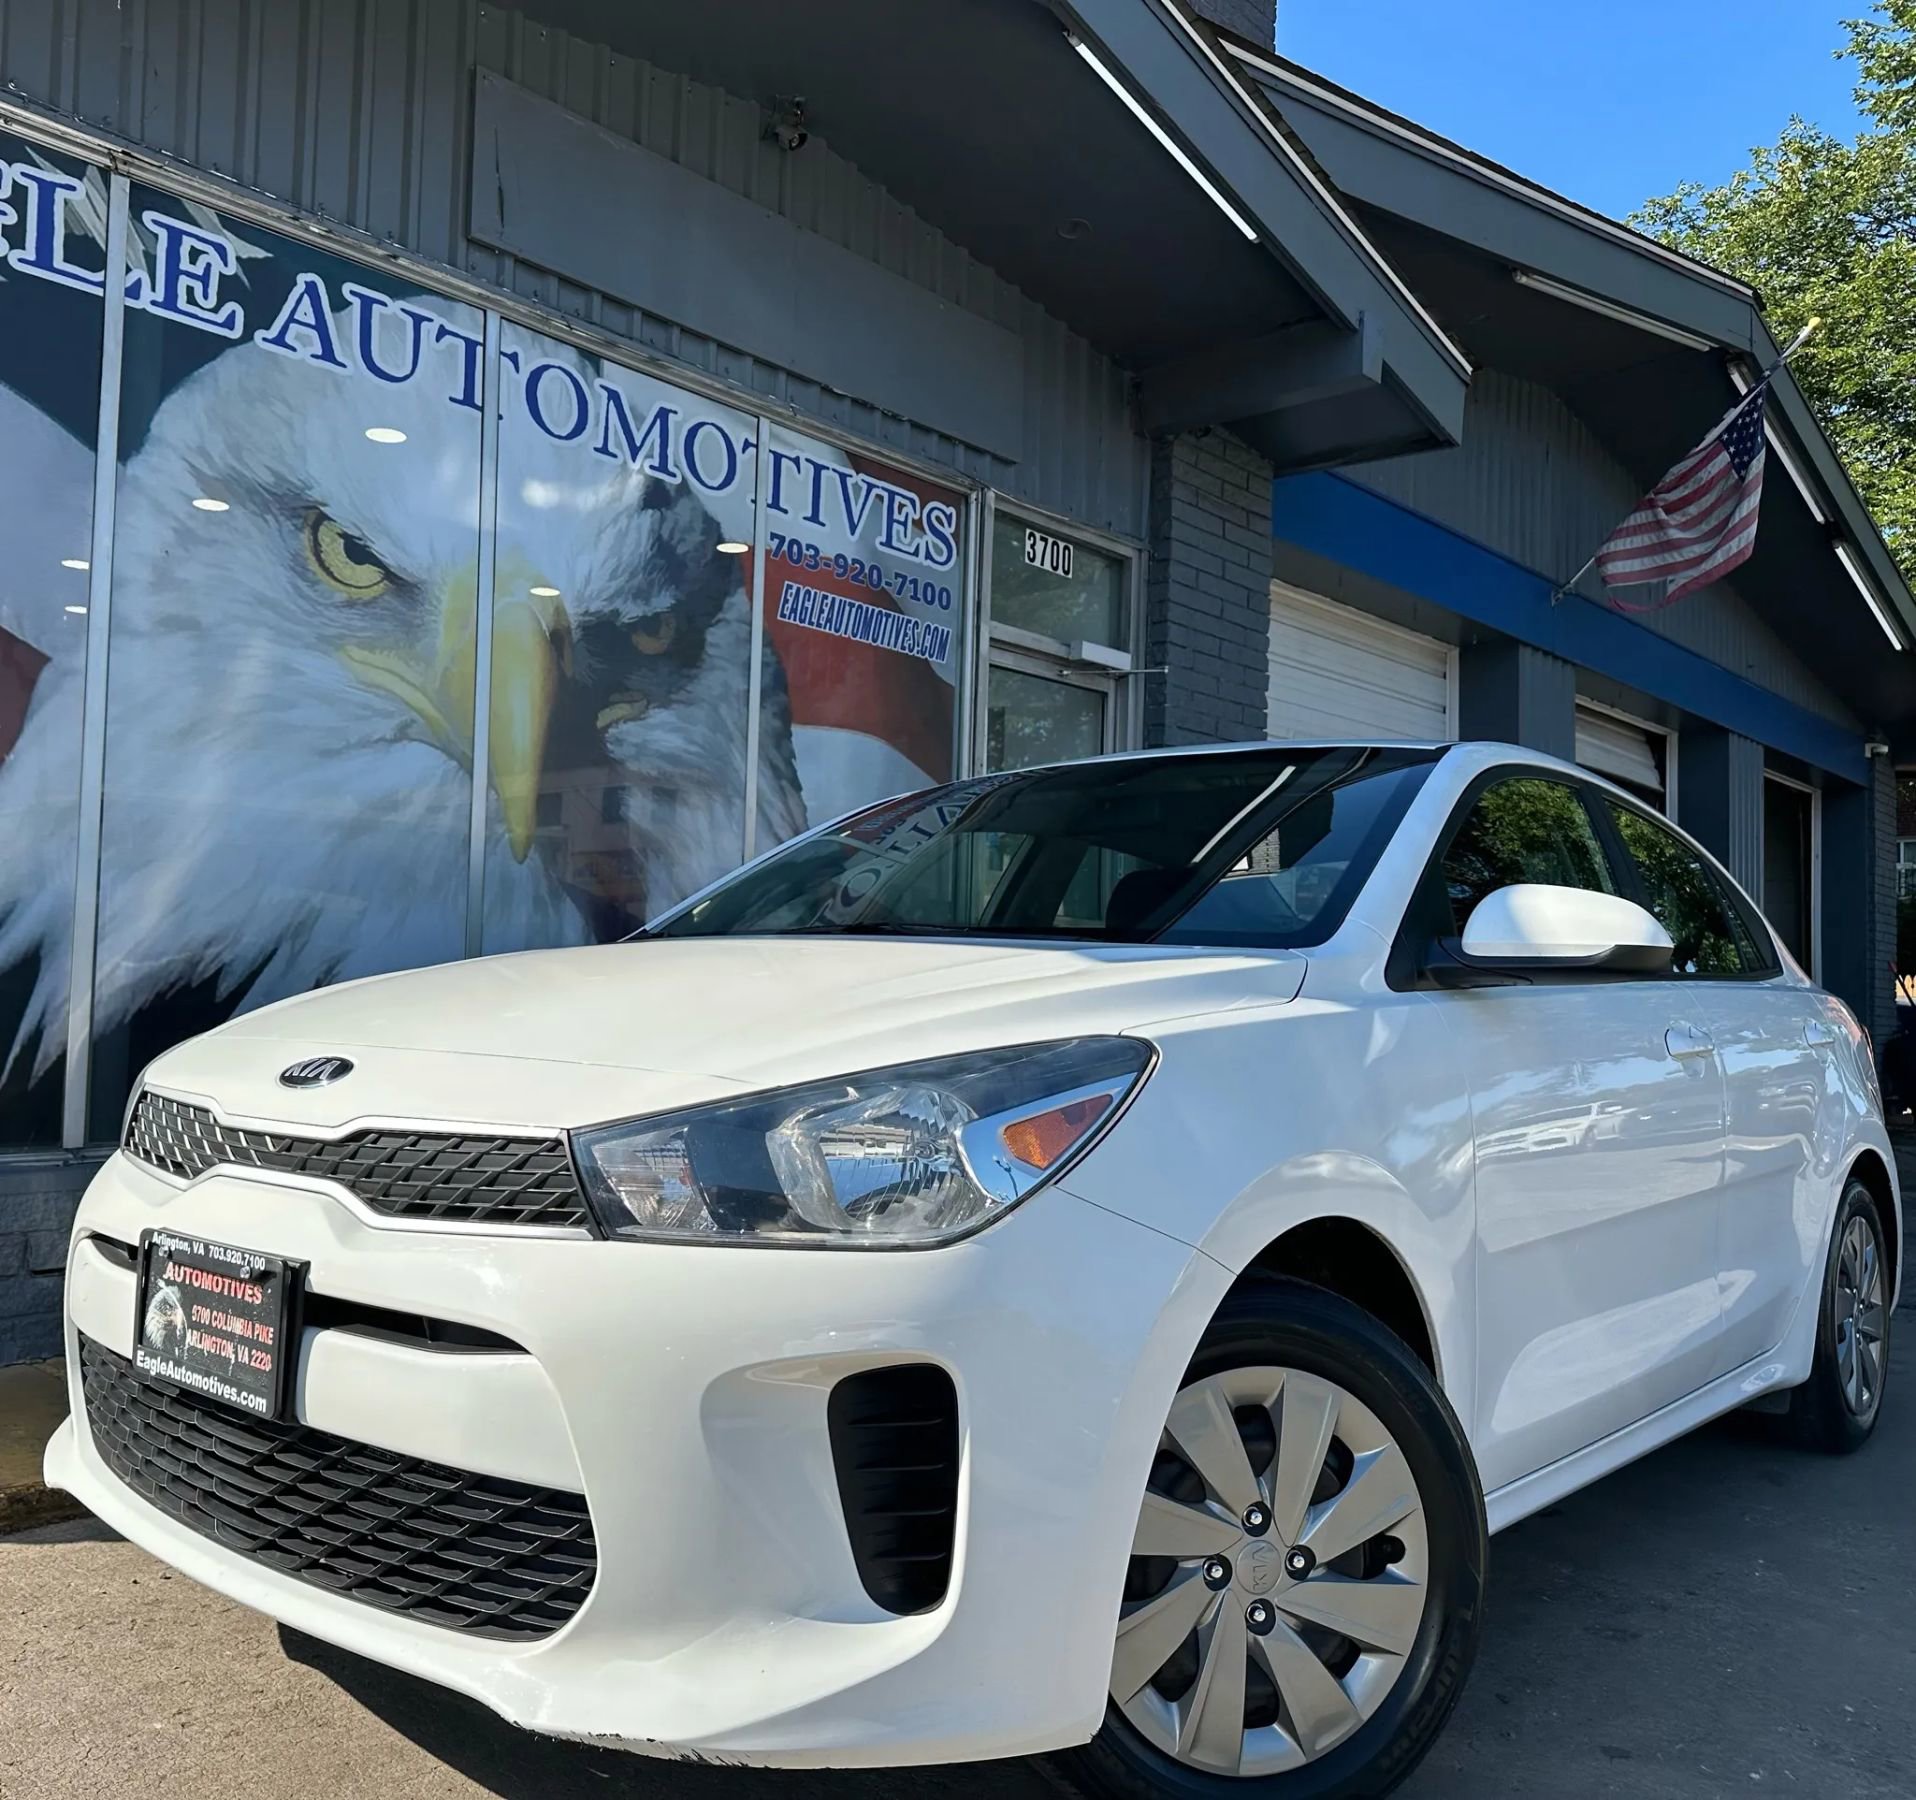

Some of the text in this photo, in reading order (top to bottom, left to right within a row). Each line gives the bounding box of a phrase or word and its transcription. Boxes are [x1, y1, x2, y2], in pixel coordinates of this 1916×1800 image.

[0, 162, 956, 569] LE AUTOMOTIVES
[769, 531, 952, 611] 703-920-7100
[1027, 531, 1071, 576] 3700
[779, 581, 951, 663] EAGLEAUTOMOTIVES.COM
[152, 1231, 266, 1271] Arlington, VA 703.920.7100
[163, 1261, 263, 1305] AUTOMOTIVES
[212, 1310, 253, 1339] COLUMBIA
[253, 1325, 274, 1346] PIKE
[237, 1344, 249, 1365] VA
[136, 1350, 267, 1413] EagleAutomotives.com
